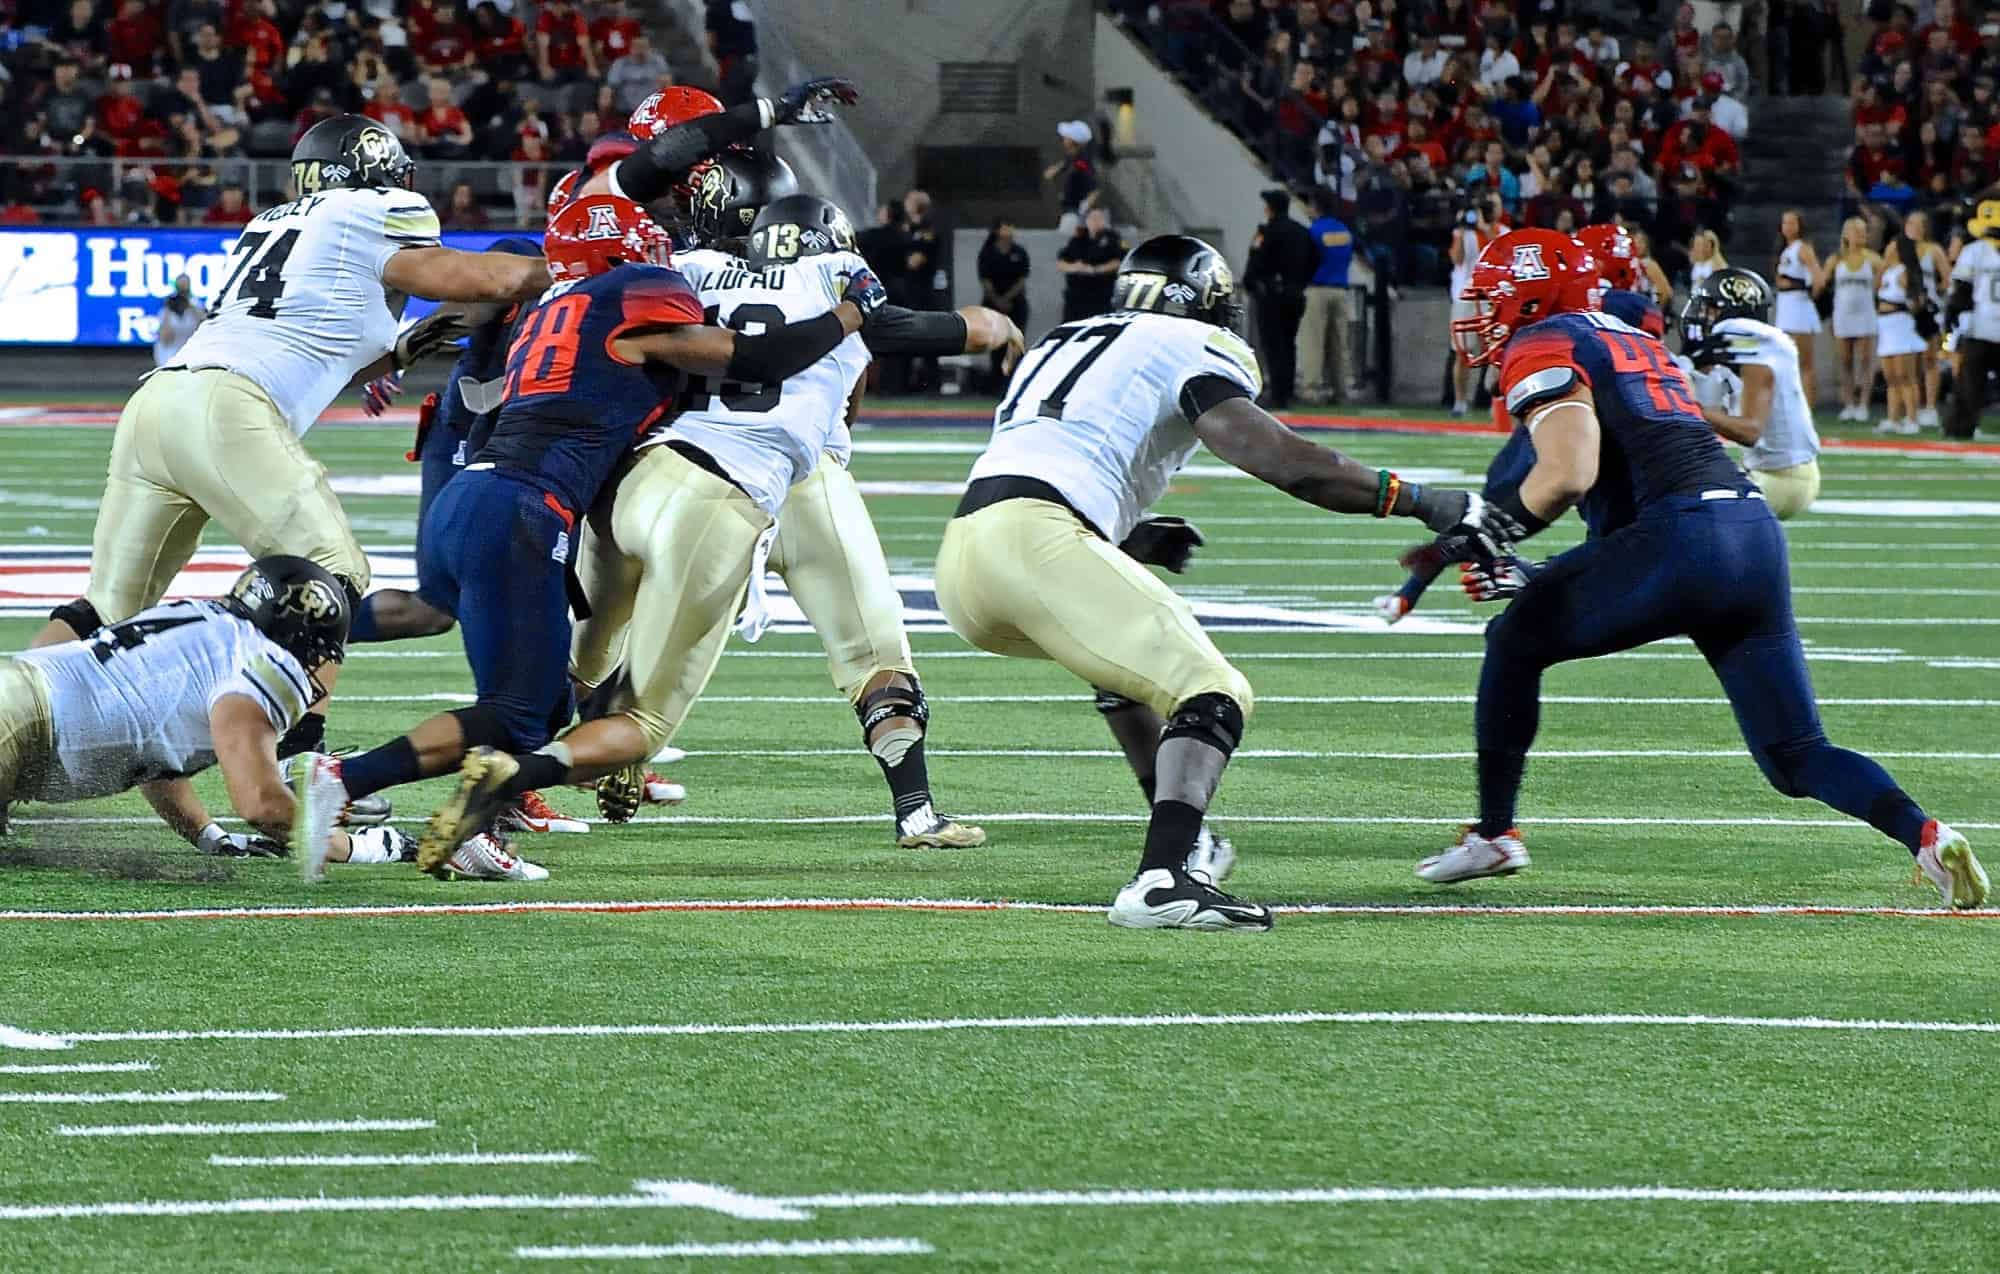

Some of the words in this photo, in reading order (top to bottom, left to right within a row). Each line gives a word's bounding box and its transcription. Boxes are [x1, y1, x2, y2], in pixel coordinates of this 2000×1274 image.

[294, 161, 322, 195] 74
[588, 205, 626, 240] A
[767, 222, 801, 259] 13
[207, 228, 303, 320] 74
[1513, 244, 1551, 281] A
[1125, 272, 1169, 310] 77
[999, 321, 1133, 425] 77
